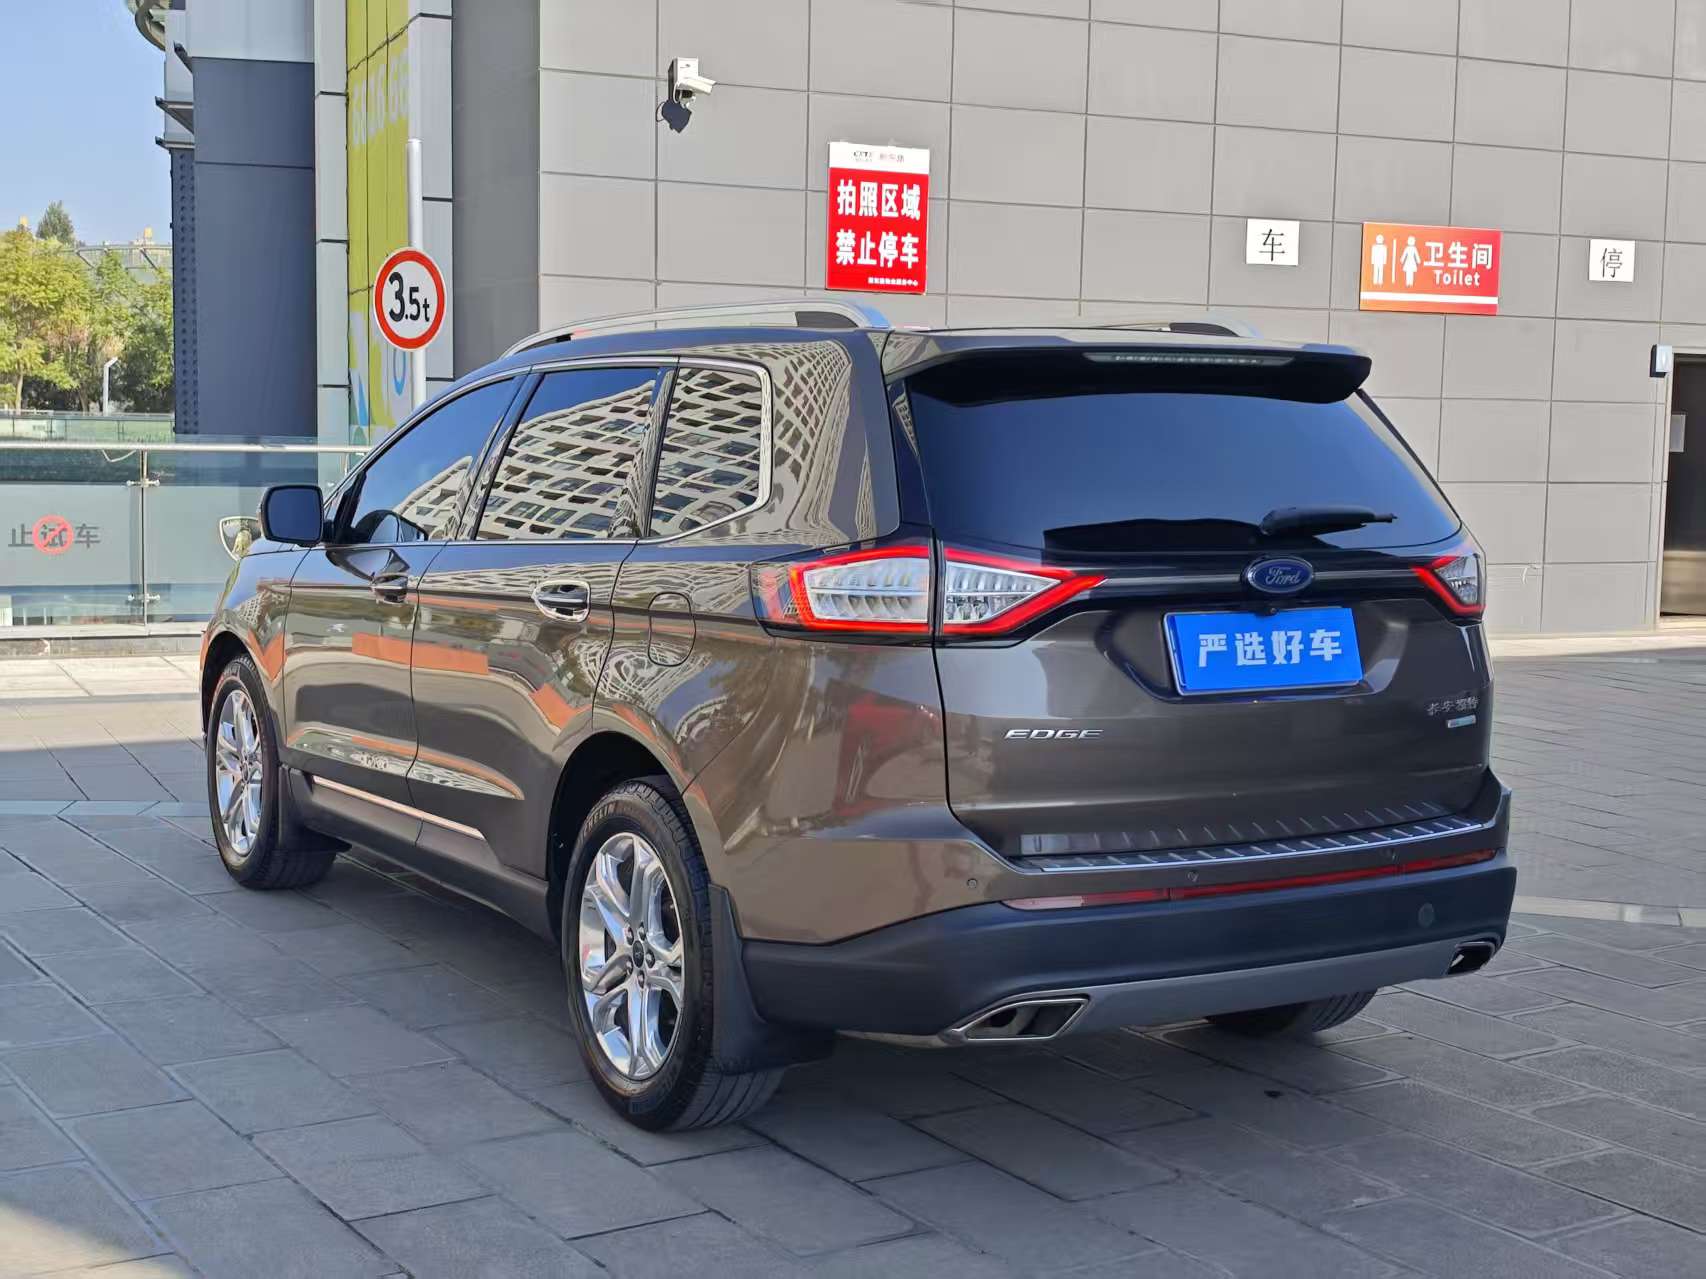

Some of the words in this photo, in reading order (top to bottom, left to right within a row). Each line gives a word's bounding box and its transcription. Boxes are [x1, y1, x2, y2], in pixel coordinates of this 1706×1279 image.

[837, 179, 921, 221] 拍照区域
[836, 229, 919, 269] 禁止停车
[1259, 228, 1285, 261] 车
[1423, 241, 1493, 270] 卫生间
[1433, 269, 1481, 287] Toilet
[1600, 247, 1623, 278] 停
[388, 271, 430, 322] 3.5t
[1265, 566, 1301, 585] Ford
[1198, 629, 1342, 668] 严选好车
[1004, 728, 1104, 740] EDGE
